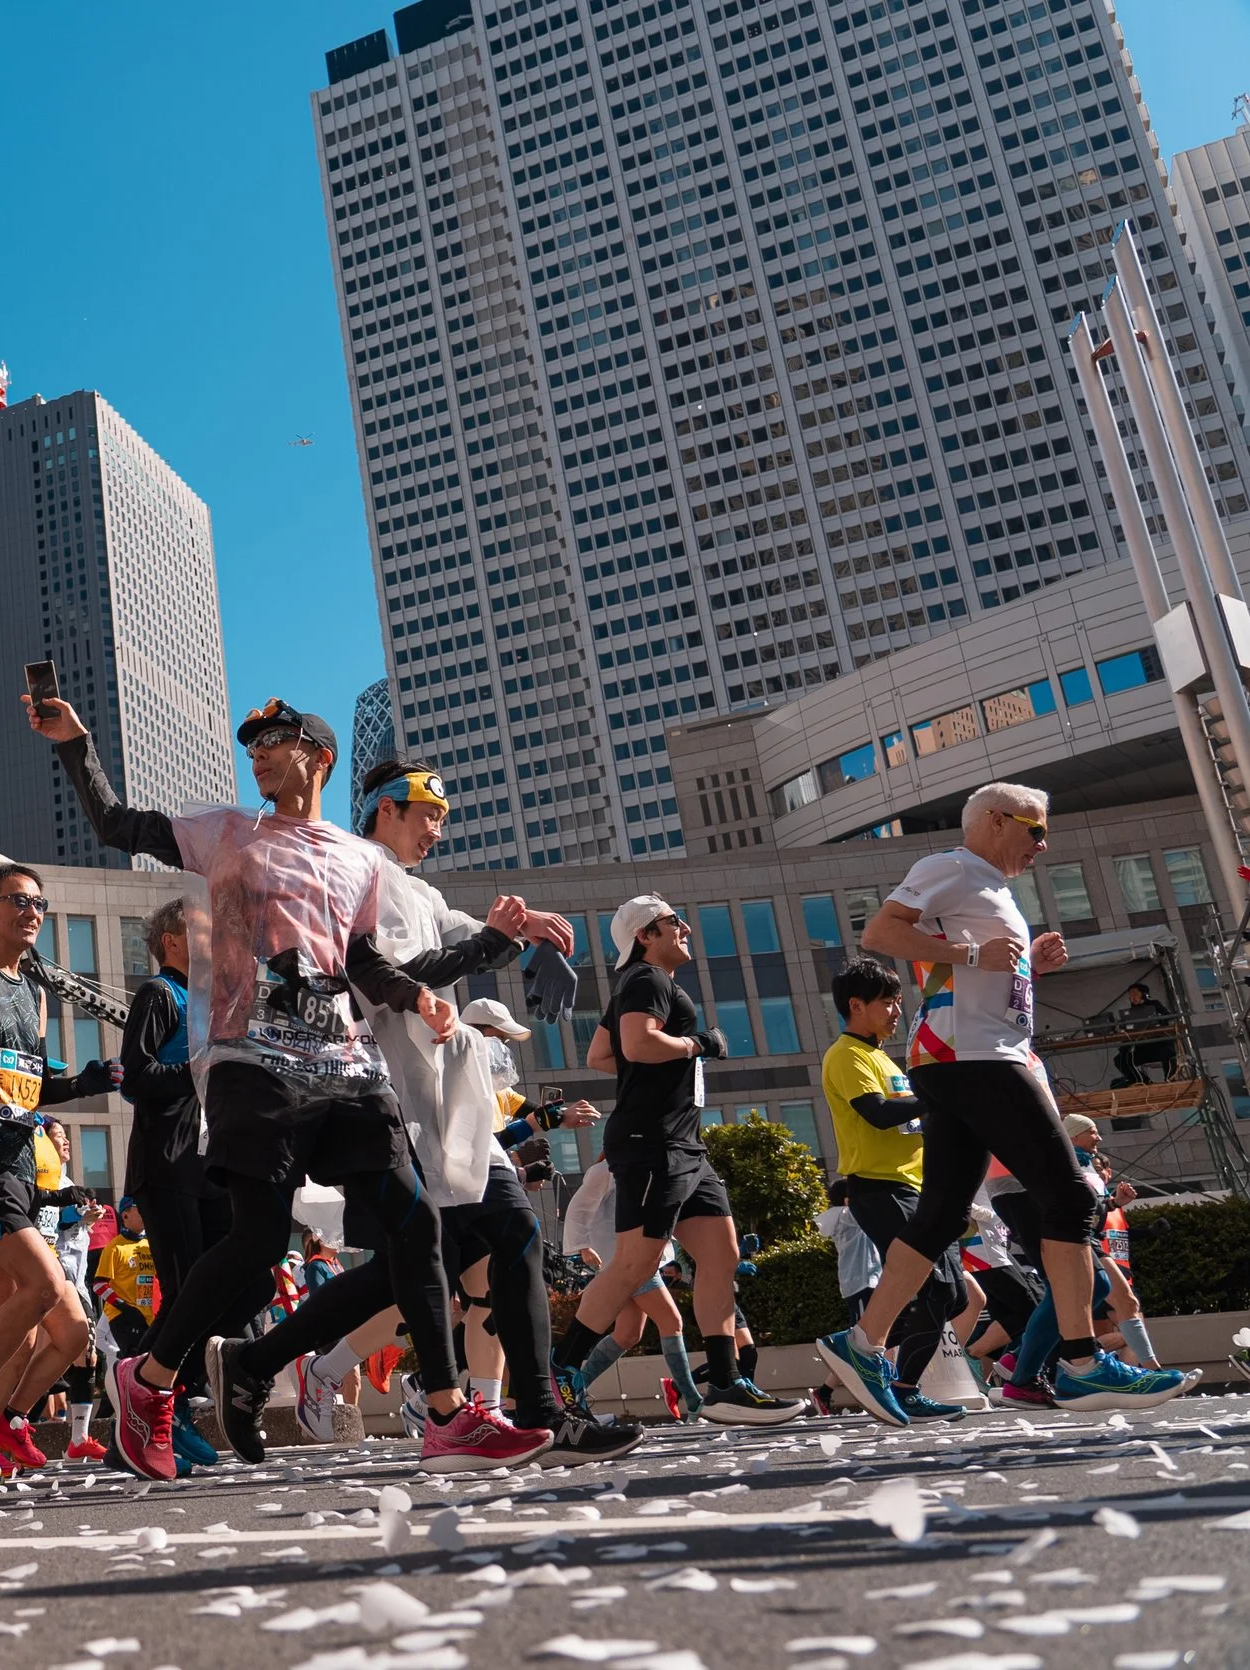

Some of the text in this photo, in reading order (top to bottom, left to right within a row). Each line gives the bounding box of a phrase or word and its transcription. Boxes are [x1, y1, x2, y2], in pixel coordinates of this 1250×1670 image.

[1014, 979, 1022, 991] D
[258, 986, 270, 999] D
[1013, 1000, 1020, 1009] 2
[256, 1009, 265, 1020] 3
